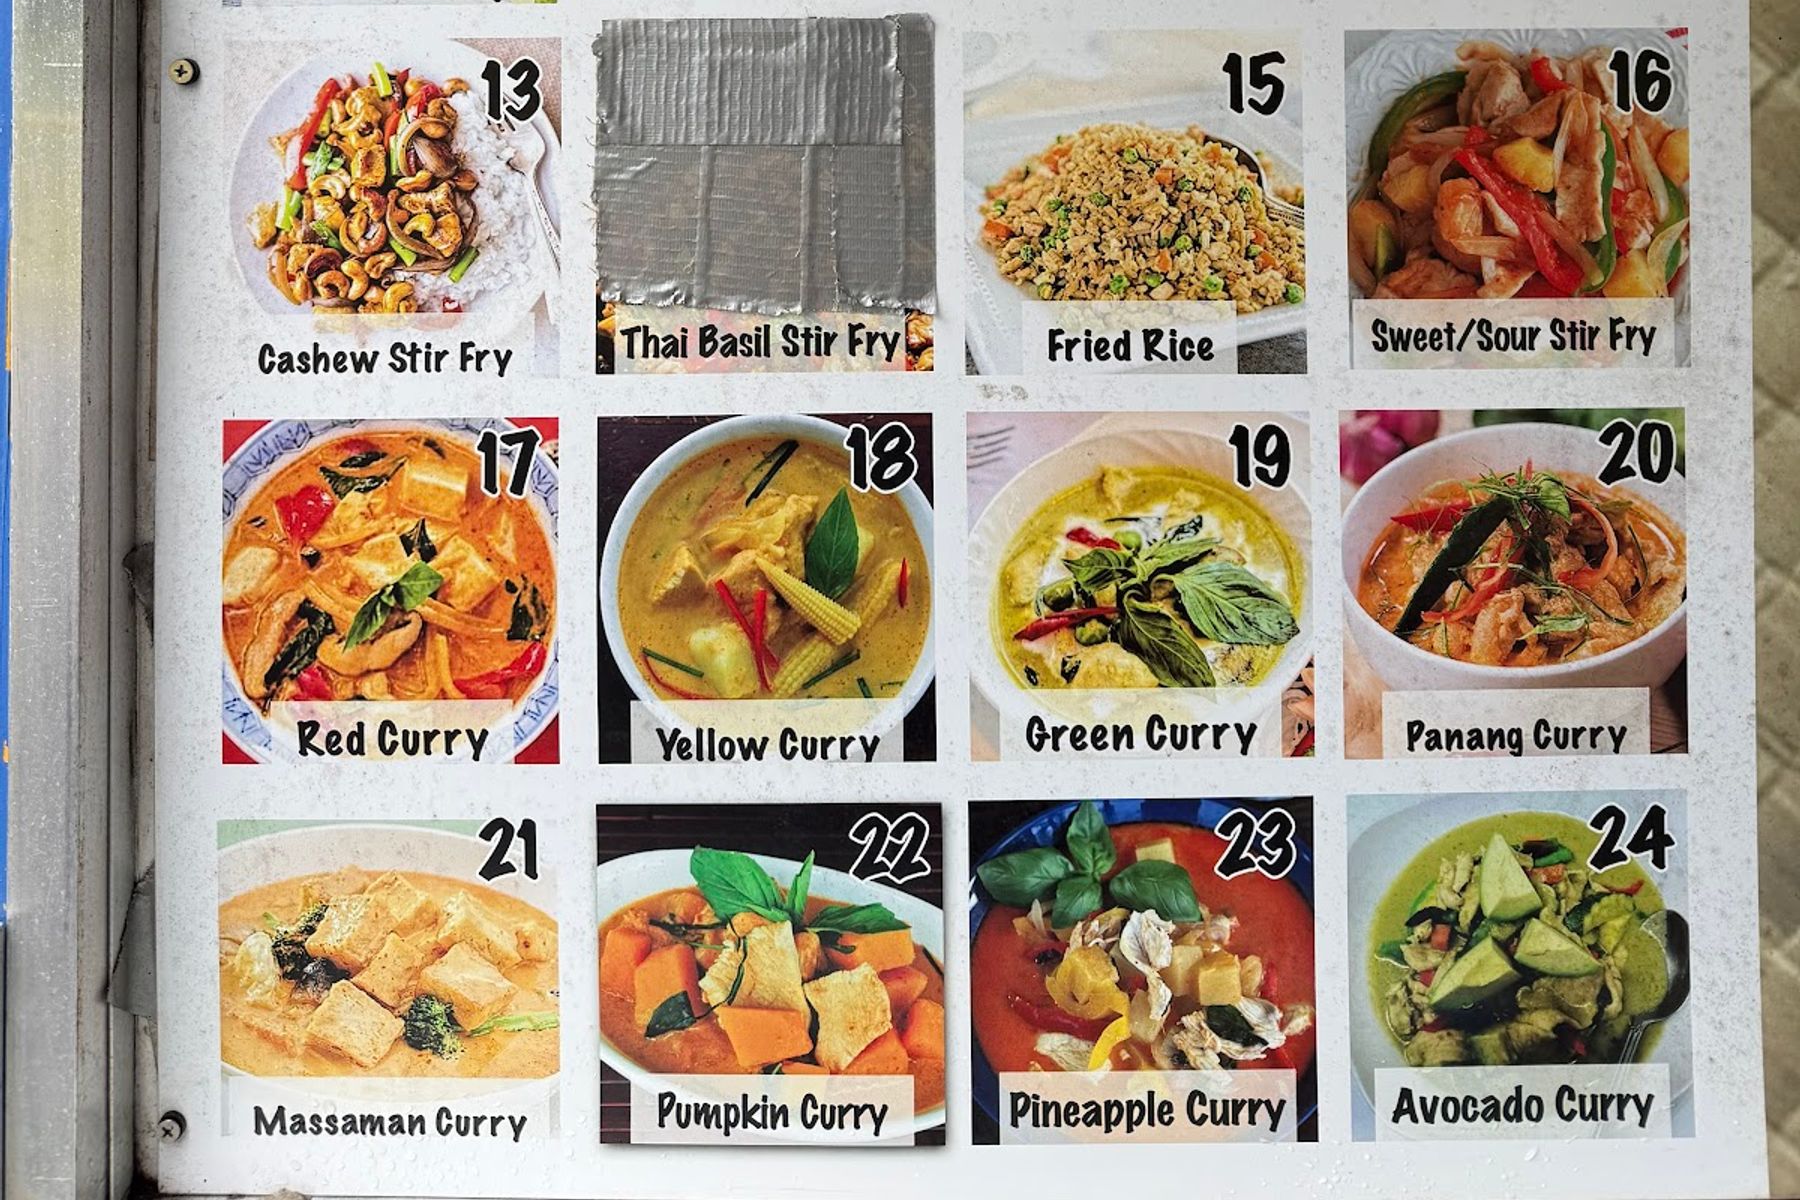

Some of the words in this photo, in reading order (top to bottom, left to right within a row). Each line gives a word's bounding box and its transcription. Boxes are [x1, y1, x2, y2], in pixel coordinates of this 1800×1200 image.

[481, 60, 540, 122] 13
[1223, 52, 1286, 113] 15
[1610, 49, 1672, 112] 16
[258, 341, 380, 375] Cashew
[387, 341, 450, 374] Stir
[459, 340, 513, 378] Fry
[619, 324, 689, 360] Thai
[698, 323, 771, 359] Basil
[781, 323, 839, 358] Stir
[847, 322, 902, 363] Fry
[1048, 328, 1132, 363] Fried
[1141, 328, 1215, 363] Rice
[1371, 317, 1542, 353] Sweet/Sour
[1549, 317, 1601, 351] Stir
[1609, 316, 1657, 357] Fry
[478, 426, 543, 497] 17
[846, 424, 916, 494] 18
[1230, 424, 1291, 489] 19
[1600, 421, 1675, 486] 20
[296, 719, 366, 757] Red
[377, 719, 489, 762] Curry
[655, 727, 770, 762] Yellow
[778, 727, 881, 763] Curry
[1025, 715, 1135, 753] Green
[1145, 713, 1258, 756] Curry
[1406, 719, 1524, 758] Panang
[1533, 718, 1628, 755] Curry
[479, 818, 538, 882] 21
[849, 814, 930, 883] 22
[1215, 809, 1295, 879] 23
[1588, 806, 1676, 871] 24
[253, 1105, 426, 1137] Massaman
[435, 1106, 528, 1143] Curry
[658, 1091, 790, 1137] Pumpkin
[800, 1093, 889, 1137] Curry
[1009, 1090, 1175, 1134] Pineapple
[1186, 1089, 1287, 1133] Curry
[1391, 1084, 1545, 1125] Avocado
[1555, 1084, 1655, 1129] Curry
